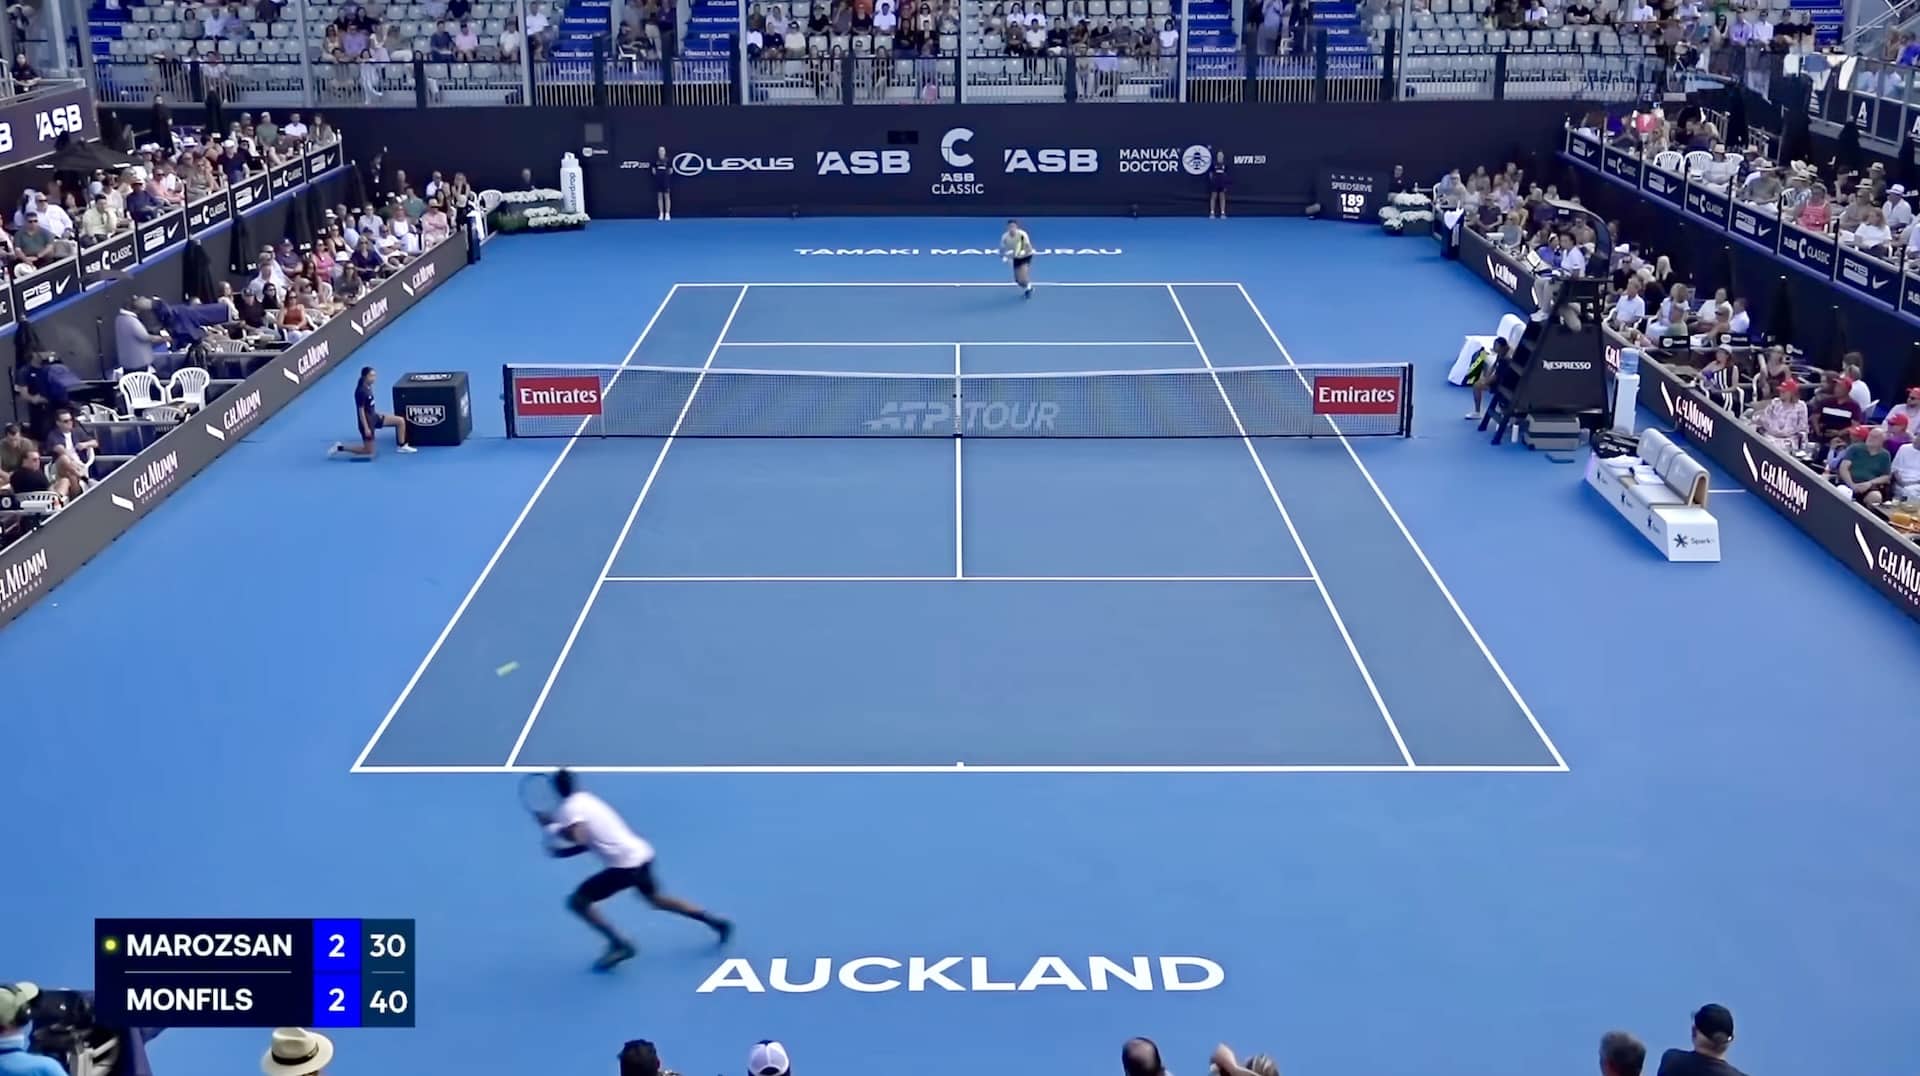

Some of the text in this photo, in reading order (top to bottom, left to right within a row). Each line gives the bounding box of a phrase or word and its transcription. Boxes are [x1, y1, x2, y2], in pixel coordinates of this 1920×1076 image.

[36, 104, 83, 141] ASB
[1004, 149, 1099, 173] ASB
[1119, 148, 1179, 160] MANUKA
[705, 157, 795, 171] LEXUS
[816, 151, 911, 175] ASB
[1119, 160, 1179, 173] DOCTOR
[941, 172, 975, 182] ASB
[931, 183, 985, 195] CLASSIC
[1340, 193, 1365, 207] 189
[110, 244, 133, 264] CLASSIC
[930, 247, 1123, 256] MAKURAU
[1806, 246, 1831, 265] CLASSIC
[1542, 359, 1592, 370] NESPRESSO
[520, 387, 597, 404] Emirates
[1319, 386, 1396, 403] Emirates
[862, 401, 1061, 430] ATP TOUR
[695, 956, 1226, 994] AUCKLAND
